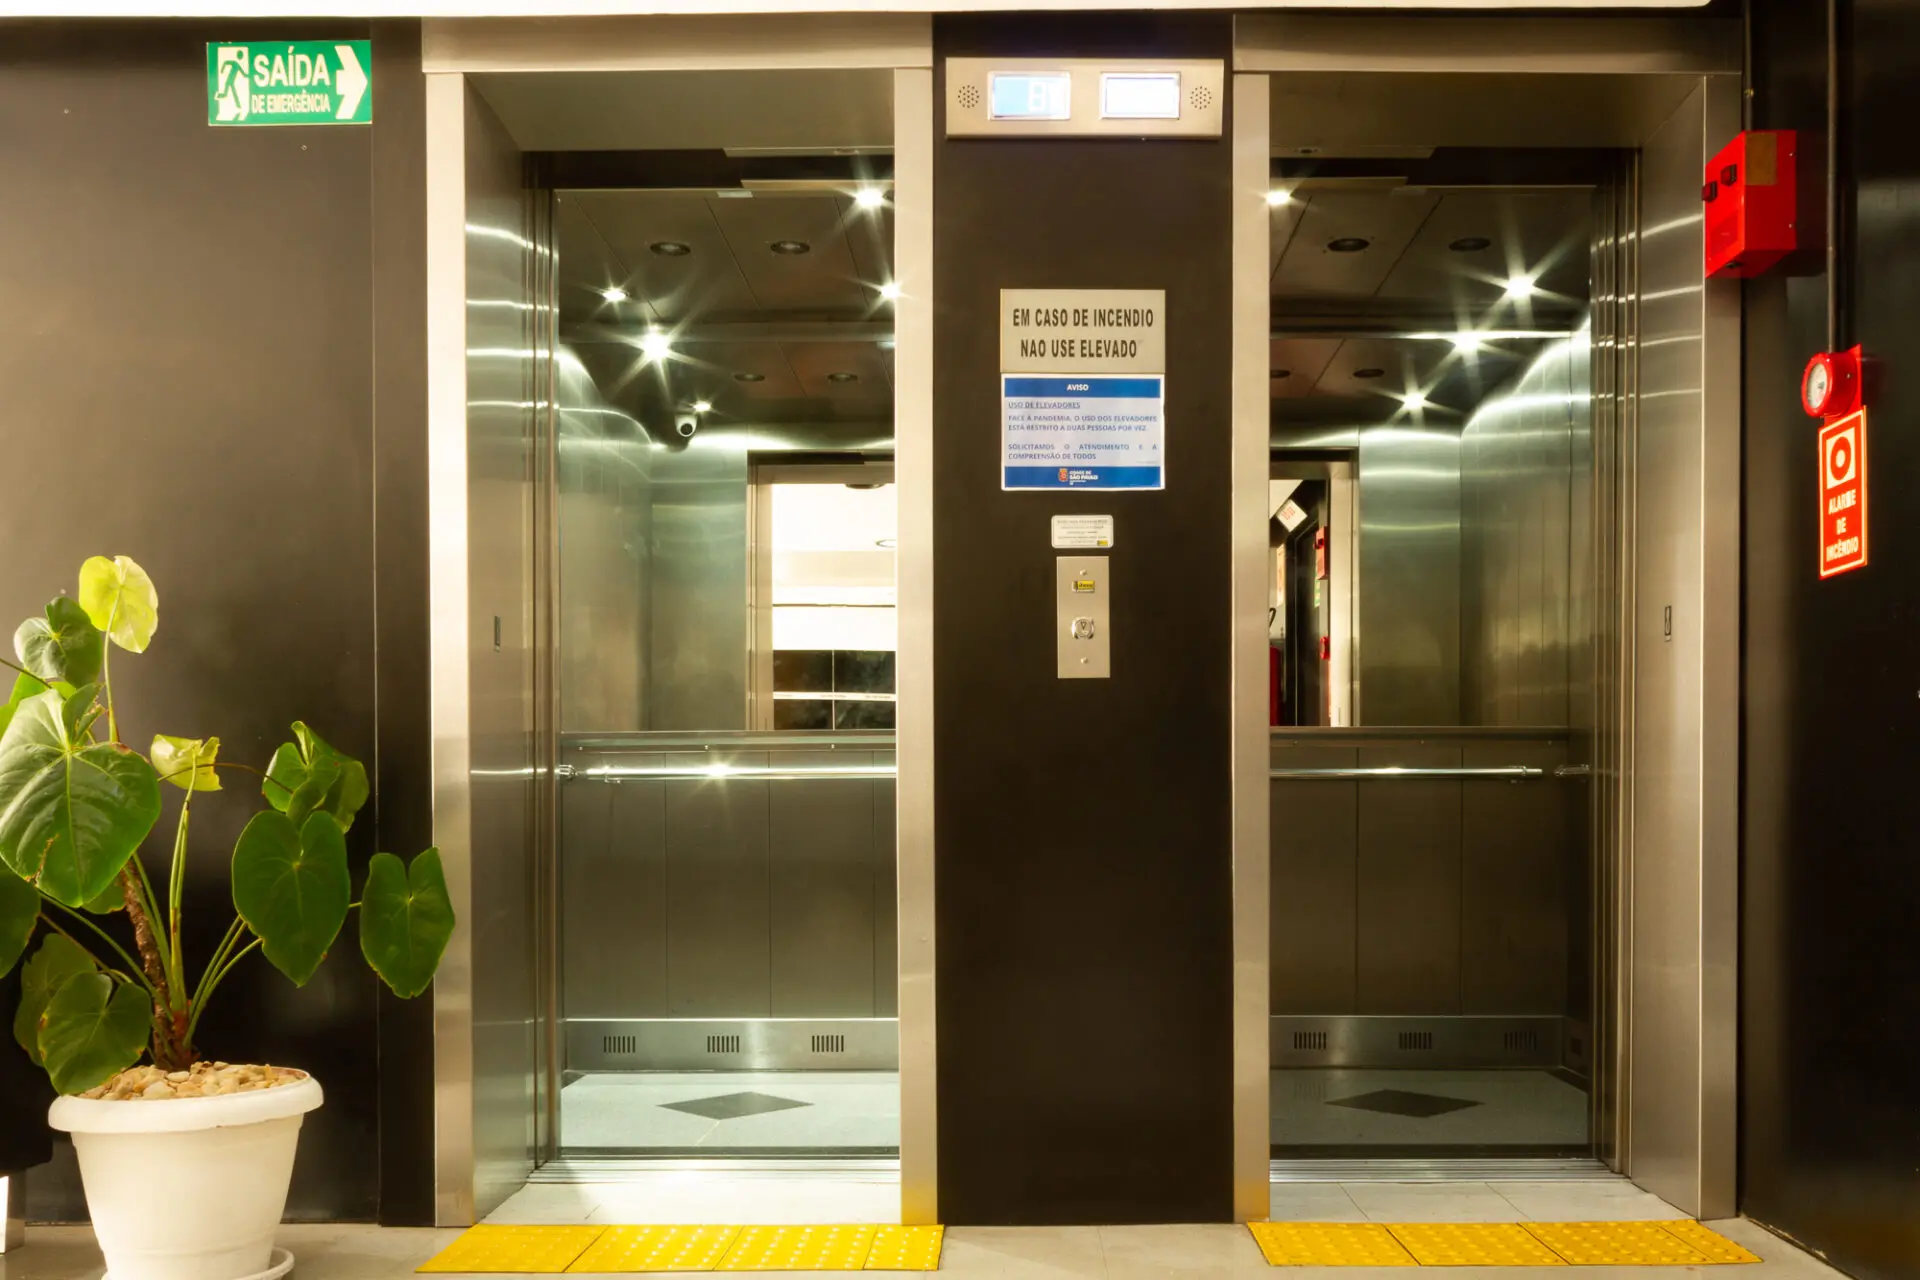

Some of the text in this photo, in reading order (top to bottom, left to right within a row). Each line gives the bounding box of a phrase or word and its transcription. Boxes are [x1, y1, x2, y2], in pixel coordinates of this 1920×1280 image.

[253, 46, 331, 87] SAÍDA
[252, 88, 331, 113] DE EMERGÊNCIA
[1013, 308, 1154, 327] EM CASO DE INCENDIO
[1020, 339, 1046, 358] NAO
[1051, 339, 1075, 358] USE
[1066, 383, 1089, 391] AVISO
[1008, 452, 1061, 460] COMPREENSÃO
[1828, 489, 1857, 514] ALARME
[1836, 517, 1847, 535] DE
[1826, 536, 1859, 562] INCÊNDIO
